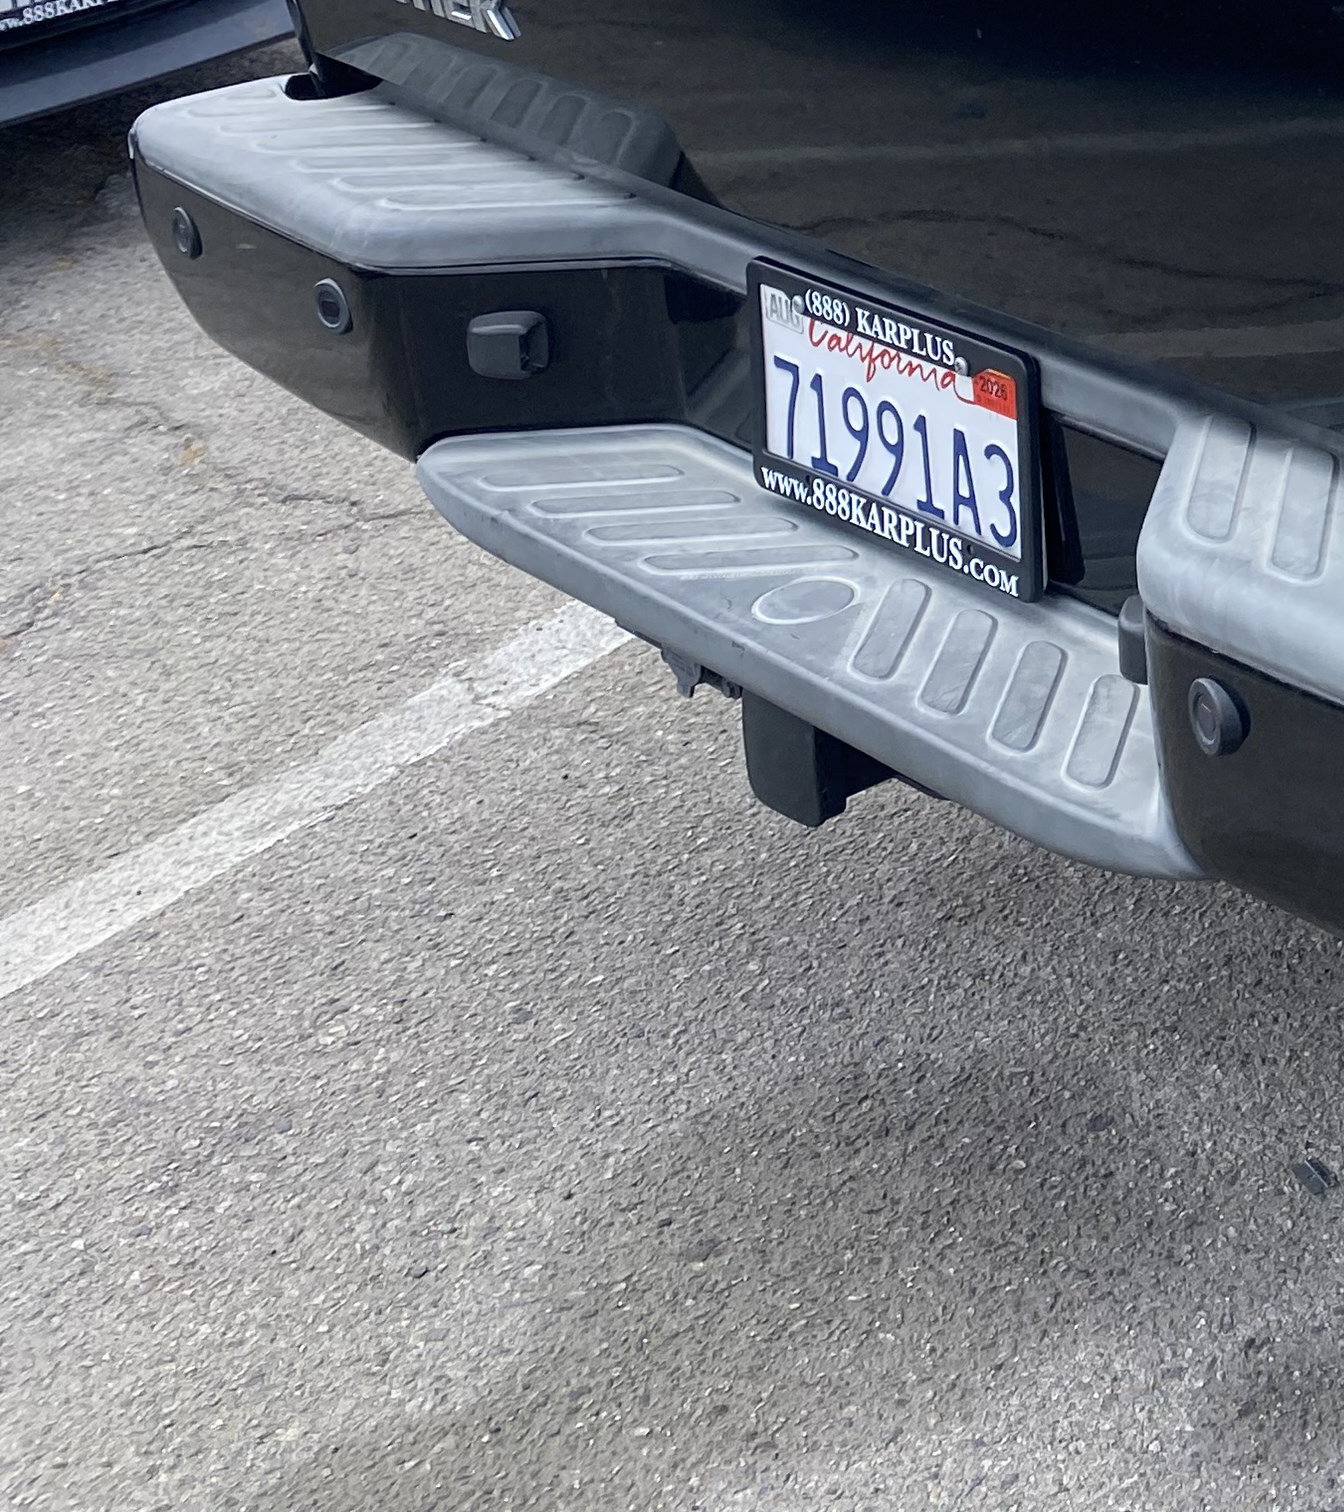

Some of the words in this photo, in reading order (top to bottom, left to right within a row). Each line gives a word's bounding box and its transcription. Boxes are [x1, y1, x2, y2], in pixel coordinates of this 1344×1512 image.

[804, 288, 851, 327] (888)
[855, 307, 956, 367] KARPLUS
[773, 354, 1018, 548] 71991A3
